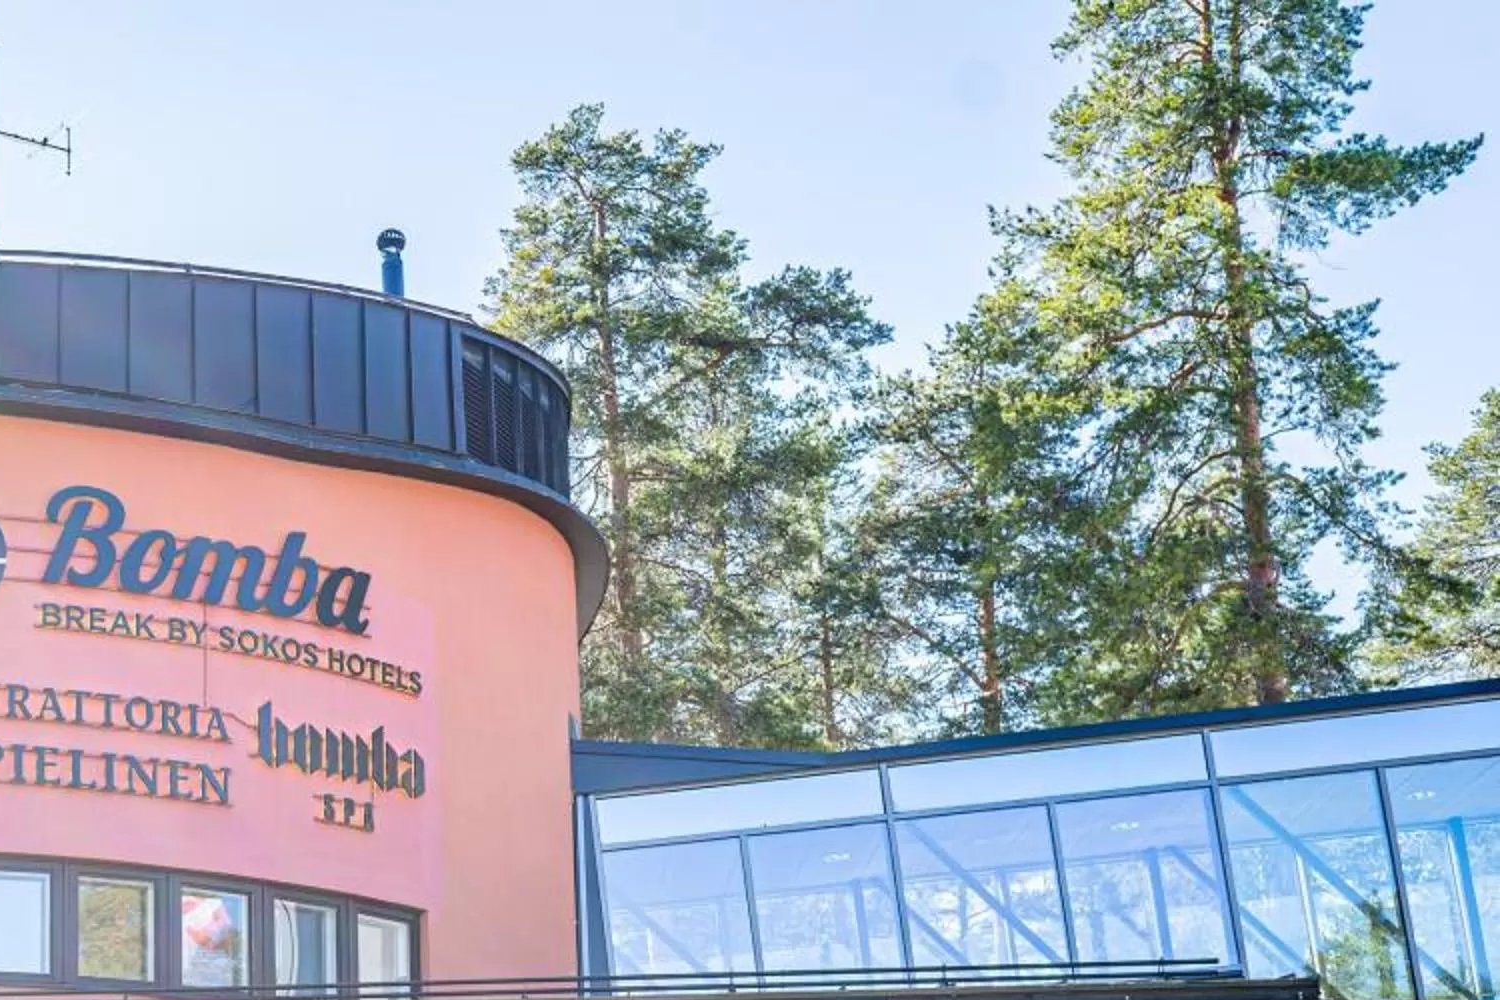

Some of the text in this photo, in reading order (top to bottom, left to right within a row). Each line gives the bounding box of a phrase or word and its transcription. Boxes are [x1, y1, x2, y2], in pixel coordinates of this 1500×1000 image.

[42, 485, 372, 636] Bomba
[41, 603, 423, 696] BREAK BY SOKOS HOTELS
[257, 700, 426, 799] bomba
